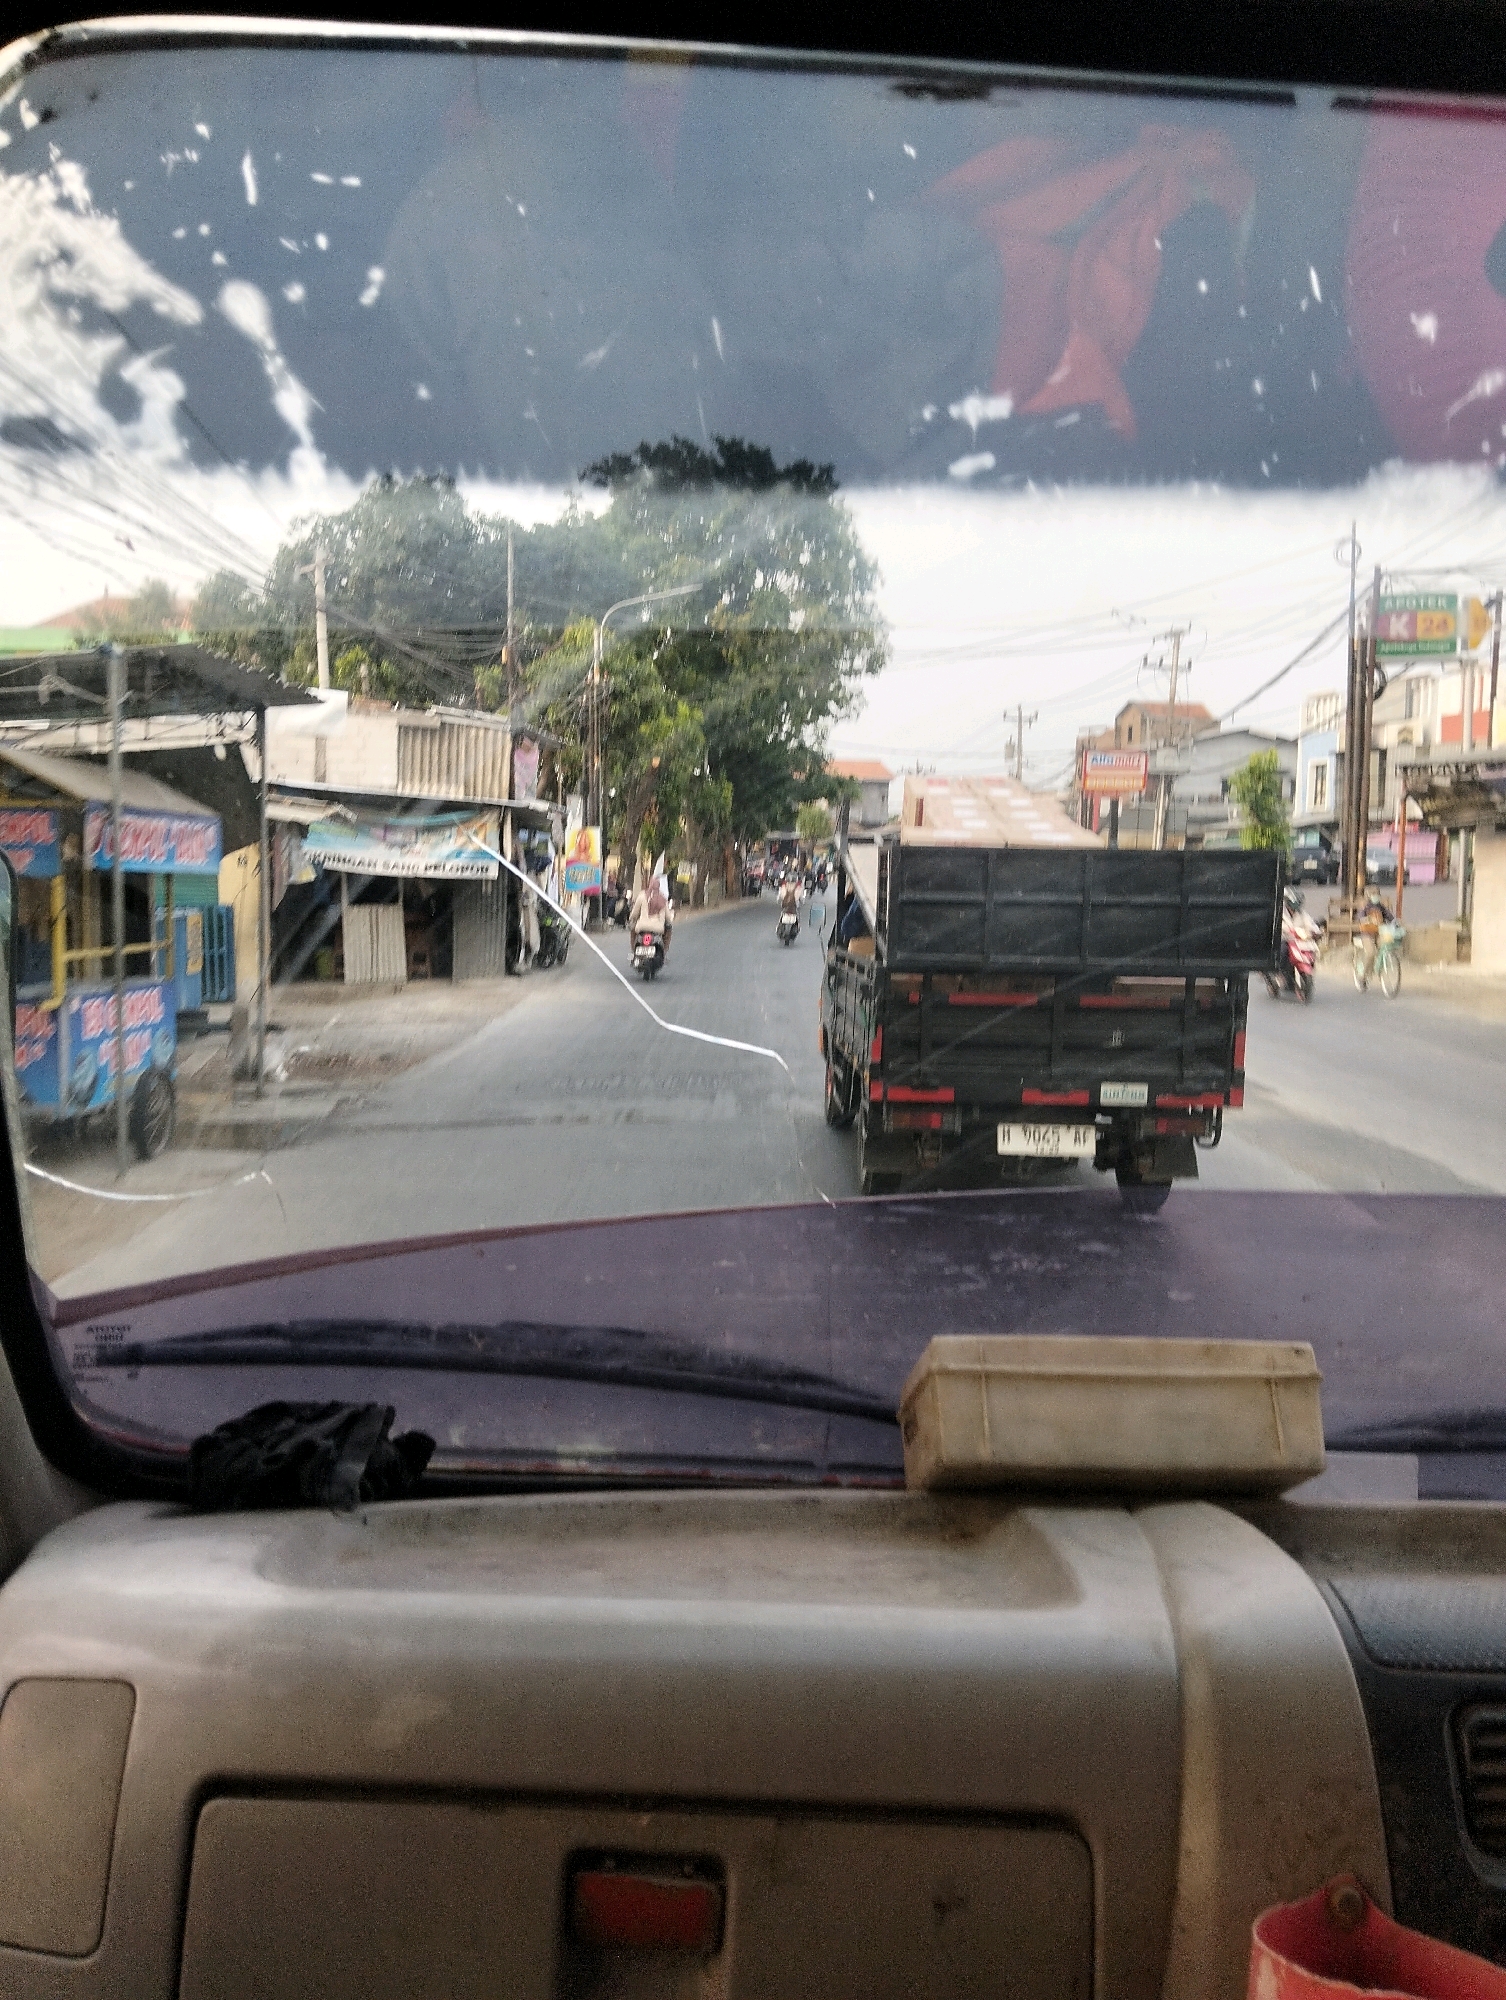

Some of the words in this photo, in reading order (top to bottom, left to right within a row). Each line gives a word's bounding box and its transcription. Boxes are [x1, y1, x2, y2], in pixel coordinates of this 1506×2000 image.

[1385, 595, 1447, 610] APOTEK
[1390, 612, 1411, 638] K
[1002, 1123, 1011, 1145] H
